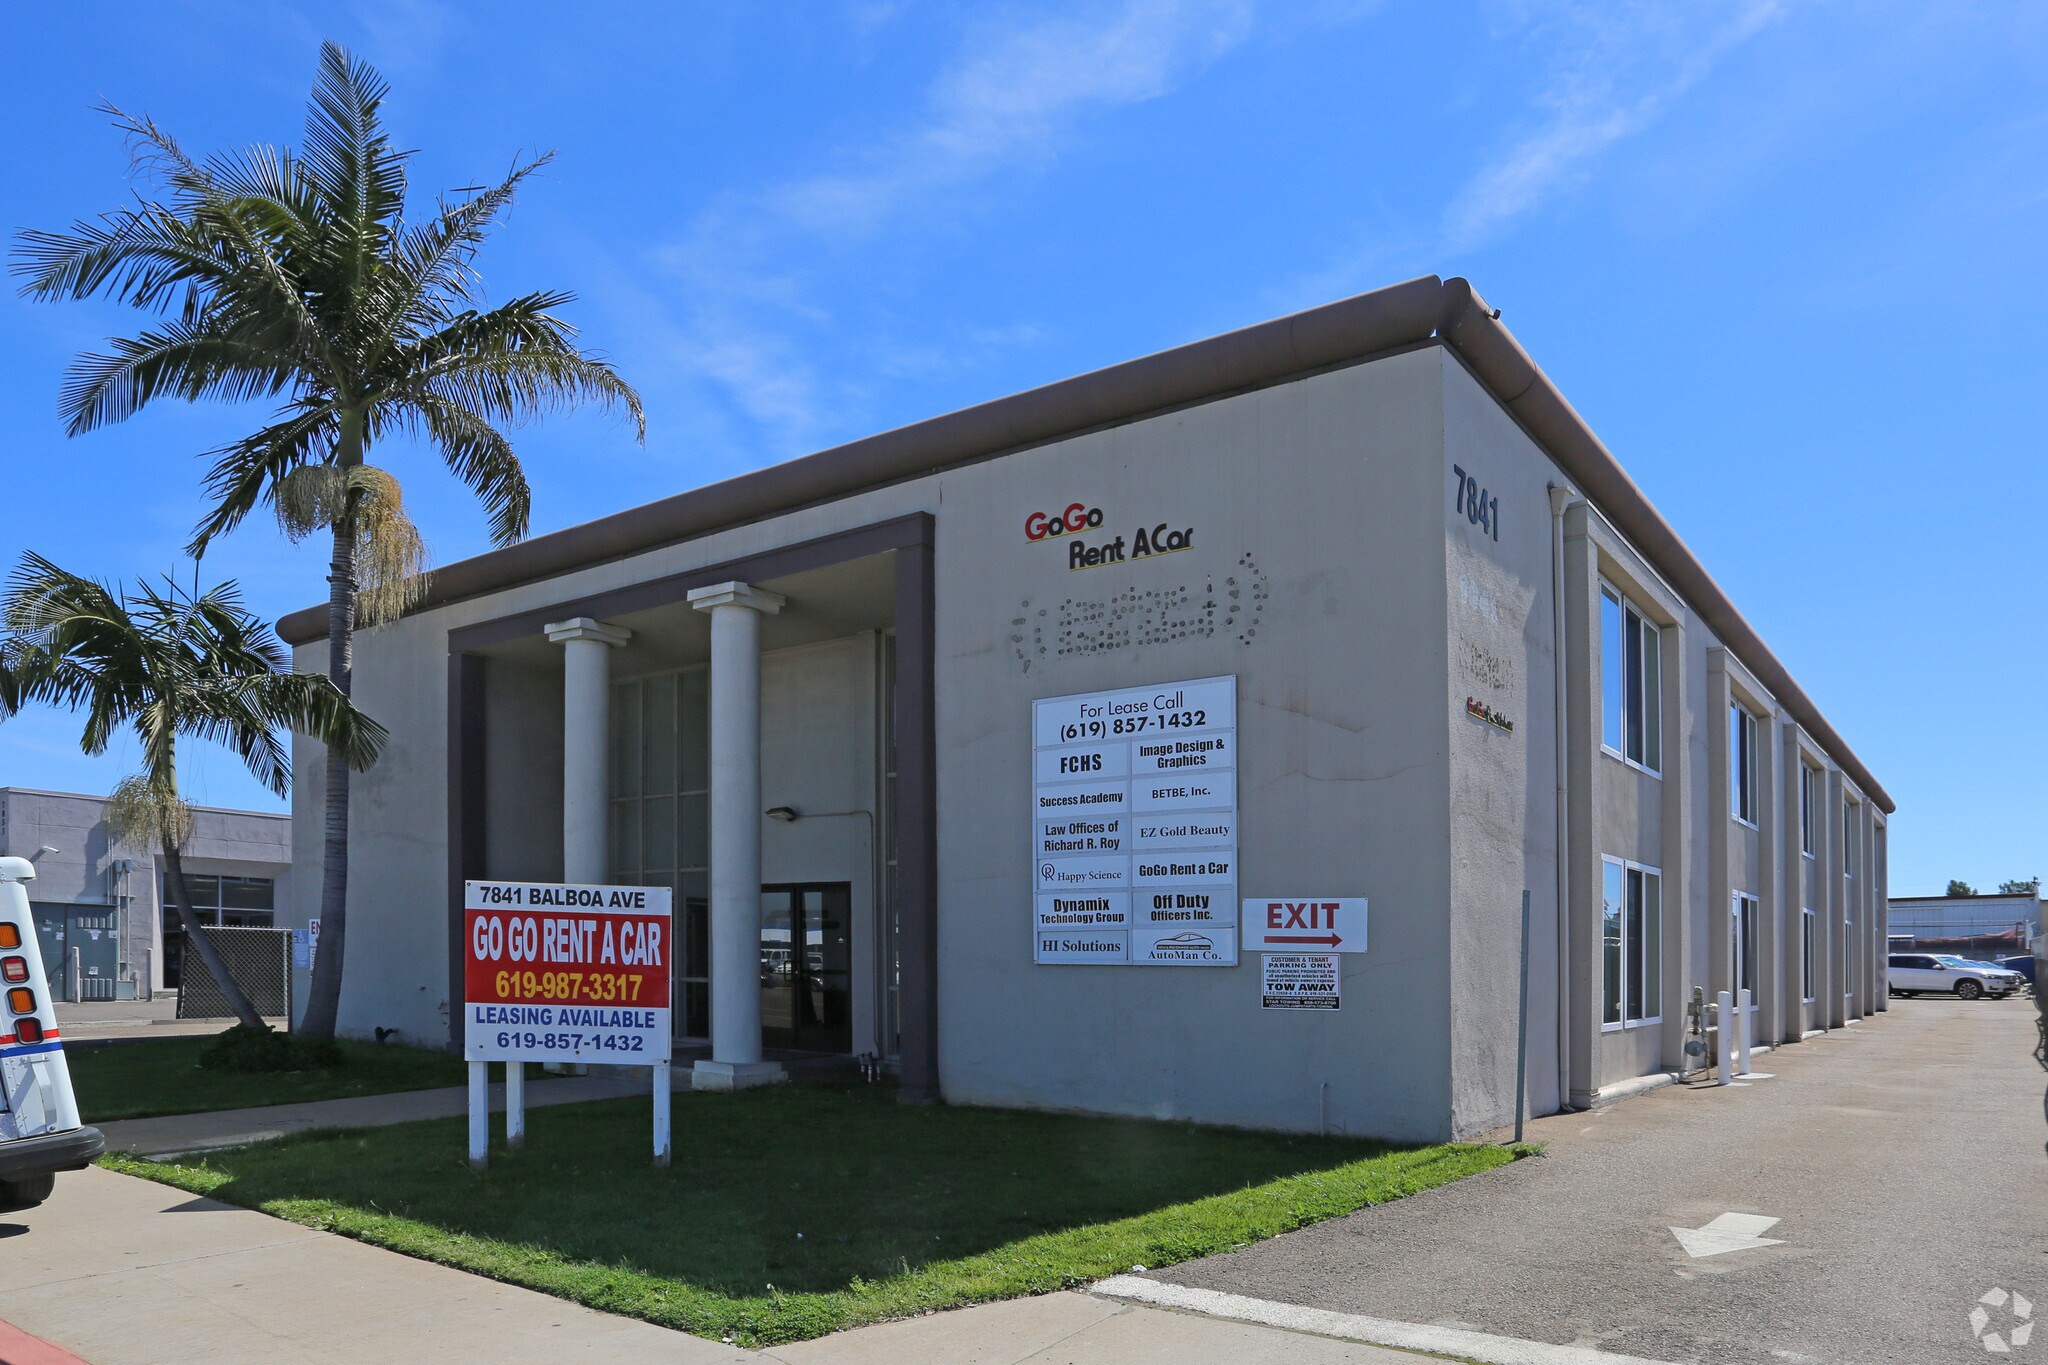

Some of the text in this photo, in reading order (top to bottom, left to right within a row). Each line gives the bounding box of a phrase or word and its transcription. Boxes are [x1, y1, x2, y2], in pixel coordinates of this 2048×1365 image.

[1454, 463, 1498, 542] 7841
[1025, 503, 1104, 540] GoGo
[1069, 536, 1125, 569] Rent
[1080, 691, 1183, 718] For Lease Call
[1060, 710, 1206, 742] (619) 857-1432
[1140, 739, 1225, 757] Image Design &
[1060, 753, 1102, 774] FCHS
[1157, 755, 1206, 769] Graphics
[1040, 792, 1123, 807] Success Academy
[1152, 786, 1211, 799] BETBE, Inc.
[1045, 820, 1119, 836] Law Offices of
[1140, 825, 1230, 838] EZ Gold Beauty
[1044, 837, 1120, 851] Richard R. Roy
[1057, 870, 1122, 882] Happy Science
[1139, 862, 1229, 877] GoGo Rent a Car
[480, 886, 645, 908] 7841 BALBOA AVE
[1054, 897, 1110, 913] Dynamix
[1153, 894, 1210, 909] Off Duty
[1040, 912, 1125, 924] Technology Group
[1151, 910, 1213, 921] Officers Inc.
[1267, 903, 1340, 929] EXIT
[473, 915, 661, 966] GO GO RENT A CAR
[1042, 939, 1121, 952] HI Solutions
[1149, 950, 1222, 960] AutoMan Co.
[495, 970, 643, 1001] 619-987-3317
[1267, 983, 1296, 991] TOW
[475, 1006, 655, 1028] LEASING AVAILABLE
[496, 1032, 643, 1051] 619-857-1432
